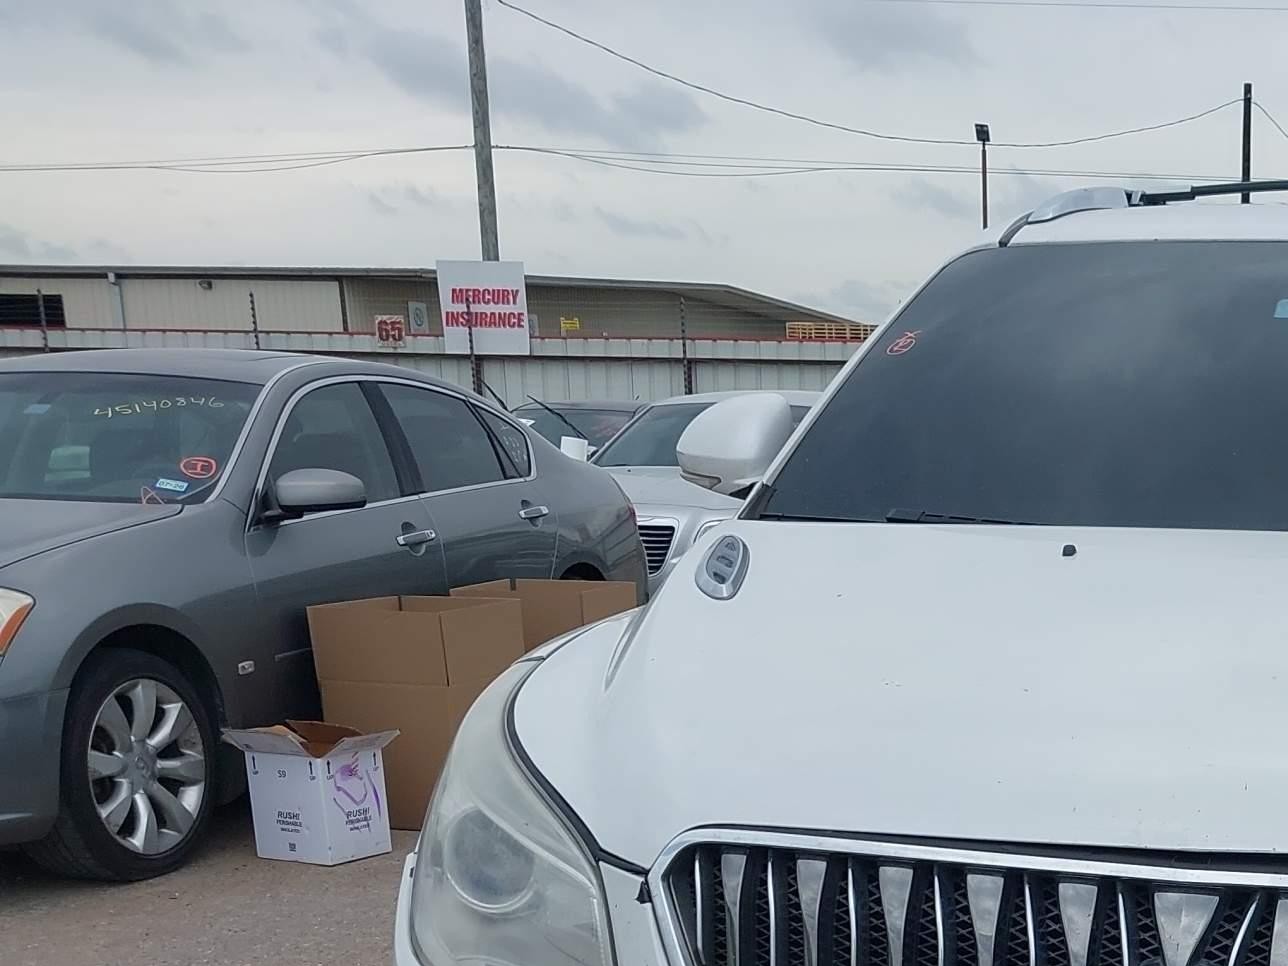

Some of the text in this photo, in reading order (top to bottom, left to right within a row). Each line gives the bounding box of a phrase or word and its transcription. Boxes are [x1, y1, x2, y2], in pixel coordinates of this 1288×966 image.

[451, 288, 520, 305] MERCURY
[445, 311, 525, 328] INSURANCE
[377, 320, 403, 342] 65
[93, 396, 225, 418] 45140846
